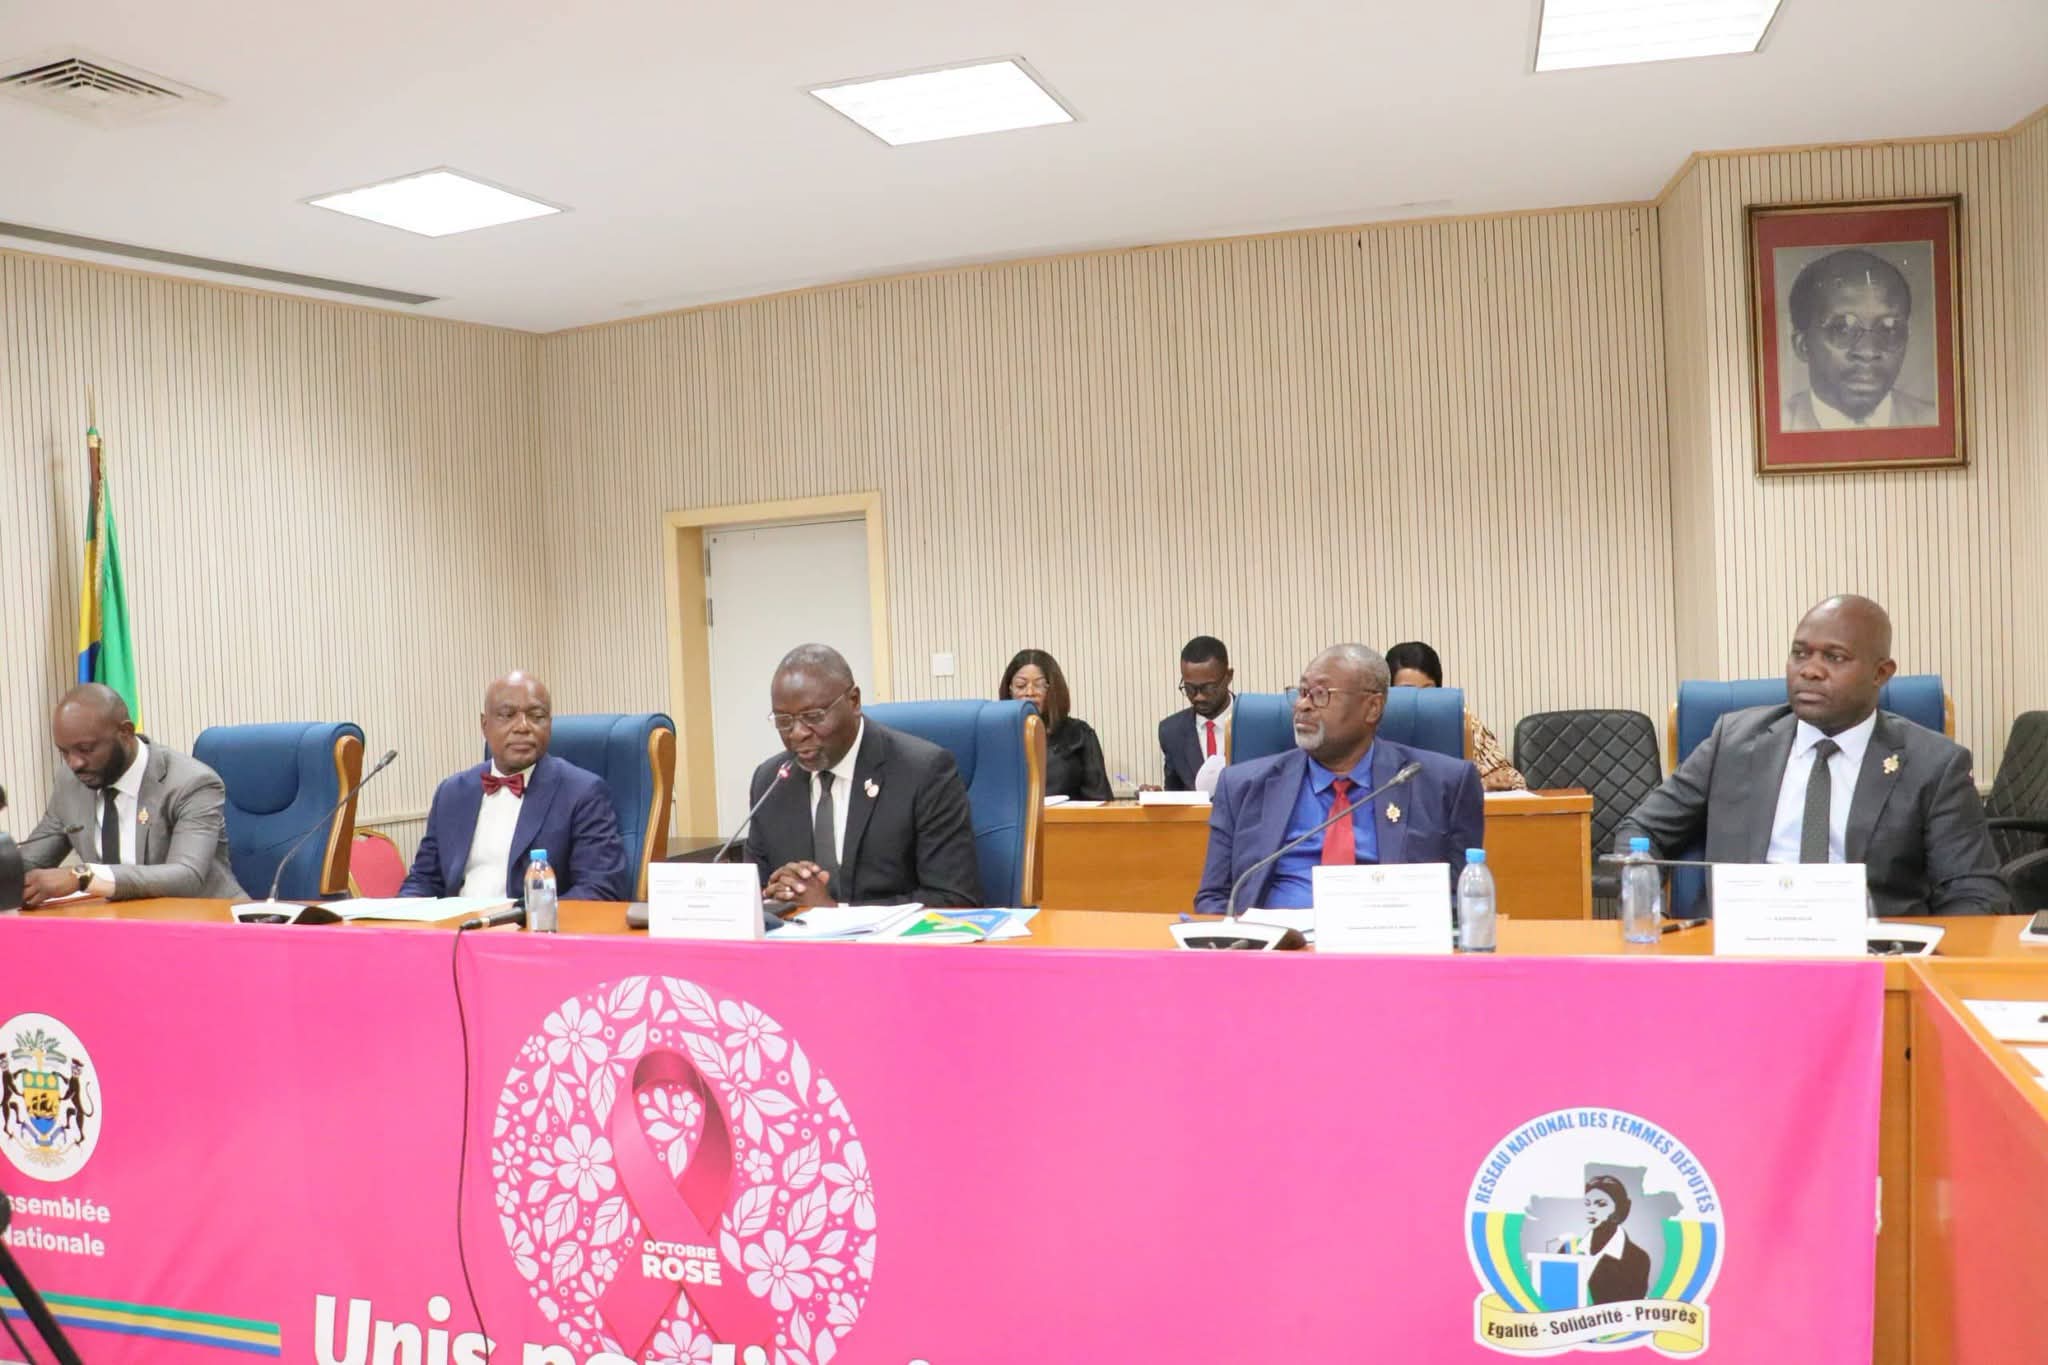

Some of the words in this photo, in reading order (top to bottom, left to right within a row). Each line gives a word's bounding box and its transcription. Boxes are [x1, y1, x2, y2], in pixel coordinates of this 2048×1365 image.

[1474, 1151, 1512, 1204] RESEAU
[1506, 1113, 1575, 1156] NATIONAL
[1578, 1111, 1608, 1129] DES
[1612, 1115, 1674, 1155] FEMMES
[1670, 1150, 1715, 1214] DEPUTES
[6, 1195, 111, 1224] ssemblée
[643, 1239, 718, 1261] OCTOBRE
[641, 1253, 723, 1287] ROSE
[1487, 1321, 1539, 1339] Egalité
[1549, 1306, 1623, 1336] Solidarité
[1635, 1305, 1698, 1325] Progrès
